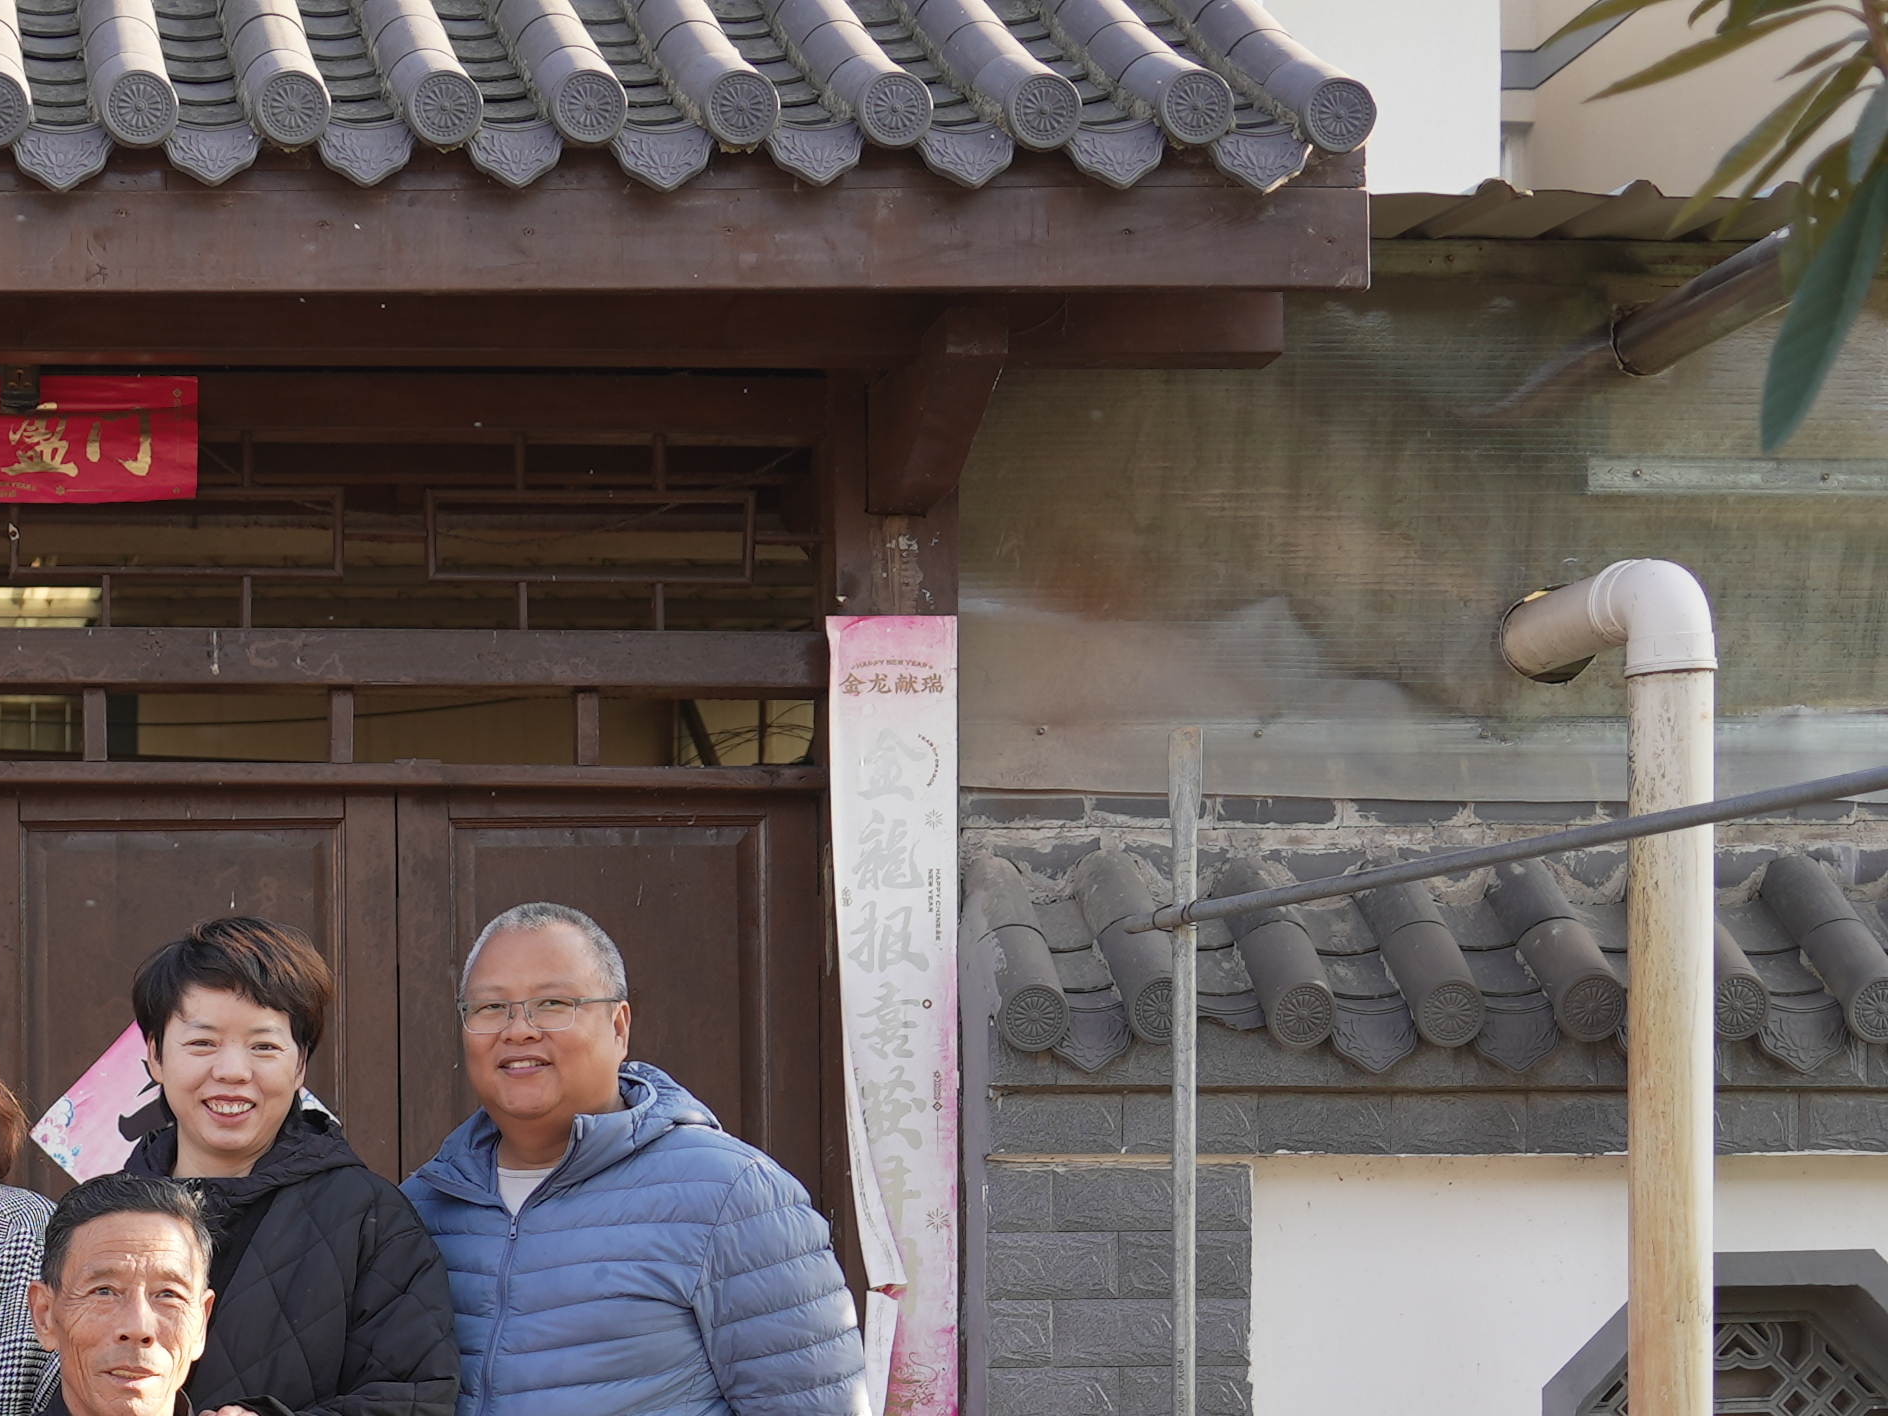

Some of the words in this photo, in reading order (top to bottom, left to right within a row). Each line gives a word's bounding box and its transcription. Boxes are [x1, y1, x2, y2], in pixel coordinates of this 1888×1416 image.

[855, 660, 884, 669] HAPPY
[905, 660, 927, 669] YEAR
[838, 673, 944, 695] 金龙献瑞
